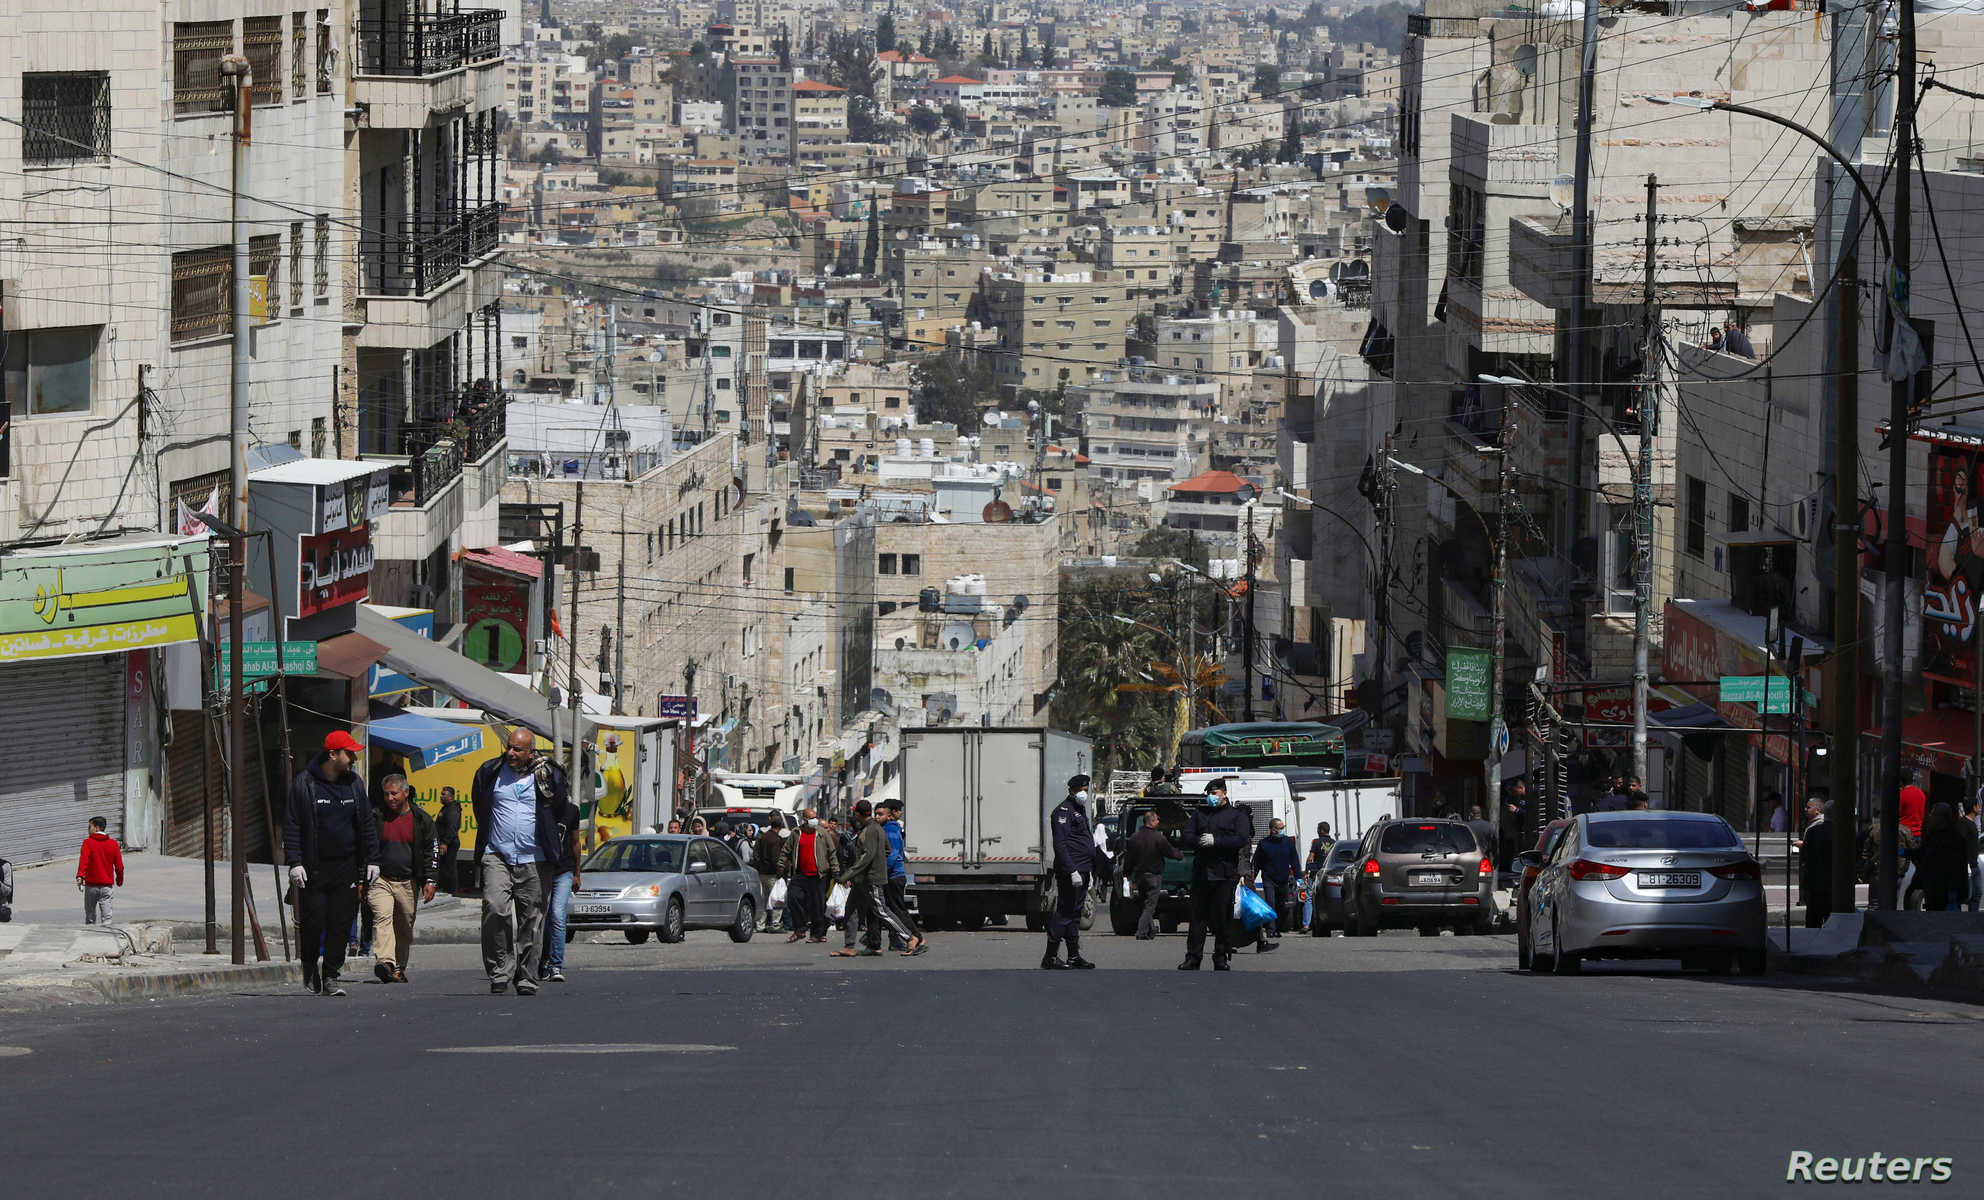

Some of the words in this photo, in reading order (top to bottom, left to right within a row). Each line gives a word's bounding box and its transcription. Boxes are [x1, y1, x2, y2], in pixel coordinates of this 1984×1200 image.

[64, 628, 110, 648] شرقية
[112, 624, 168, 643] مطرزات
[133, 670, 145, 799] SARA
[1650, 874, 1699, 884] 81-26309
